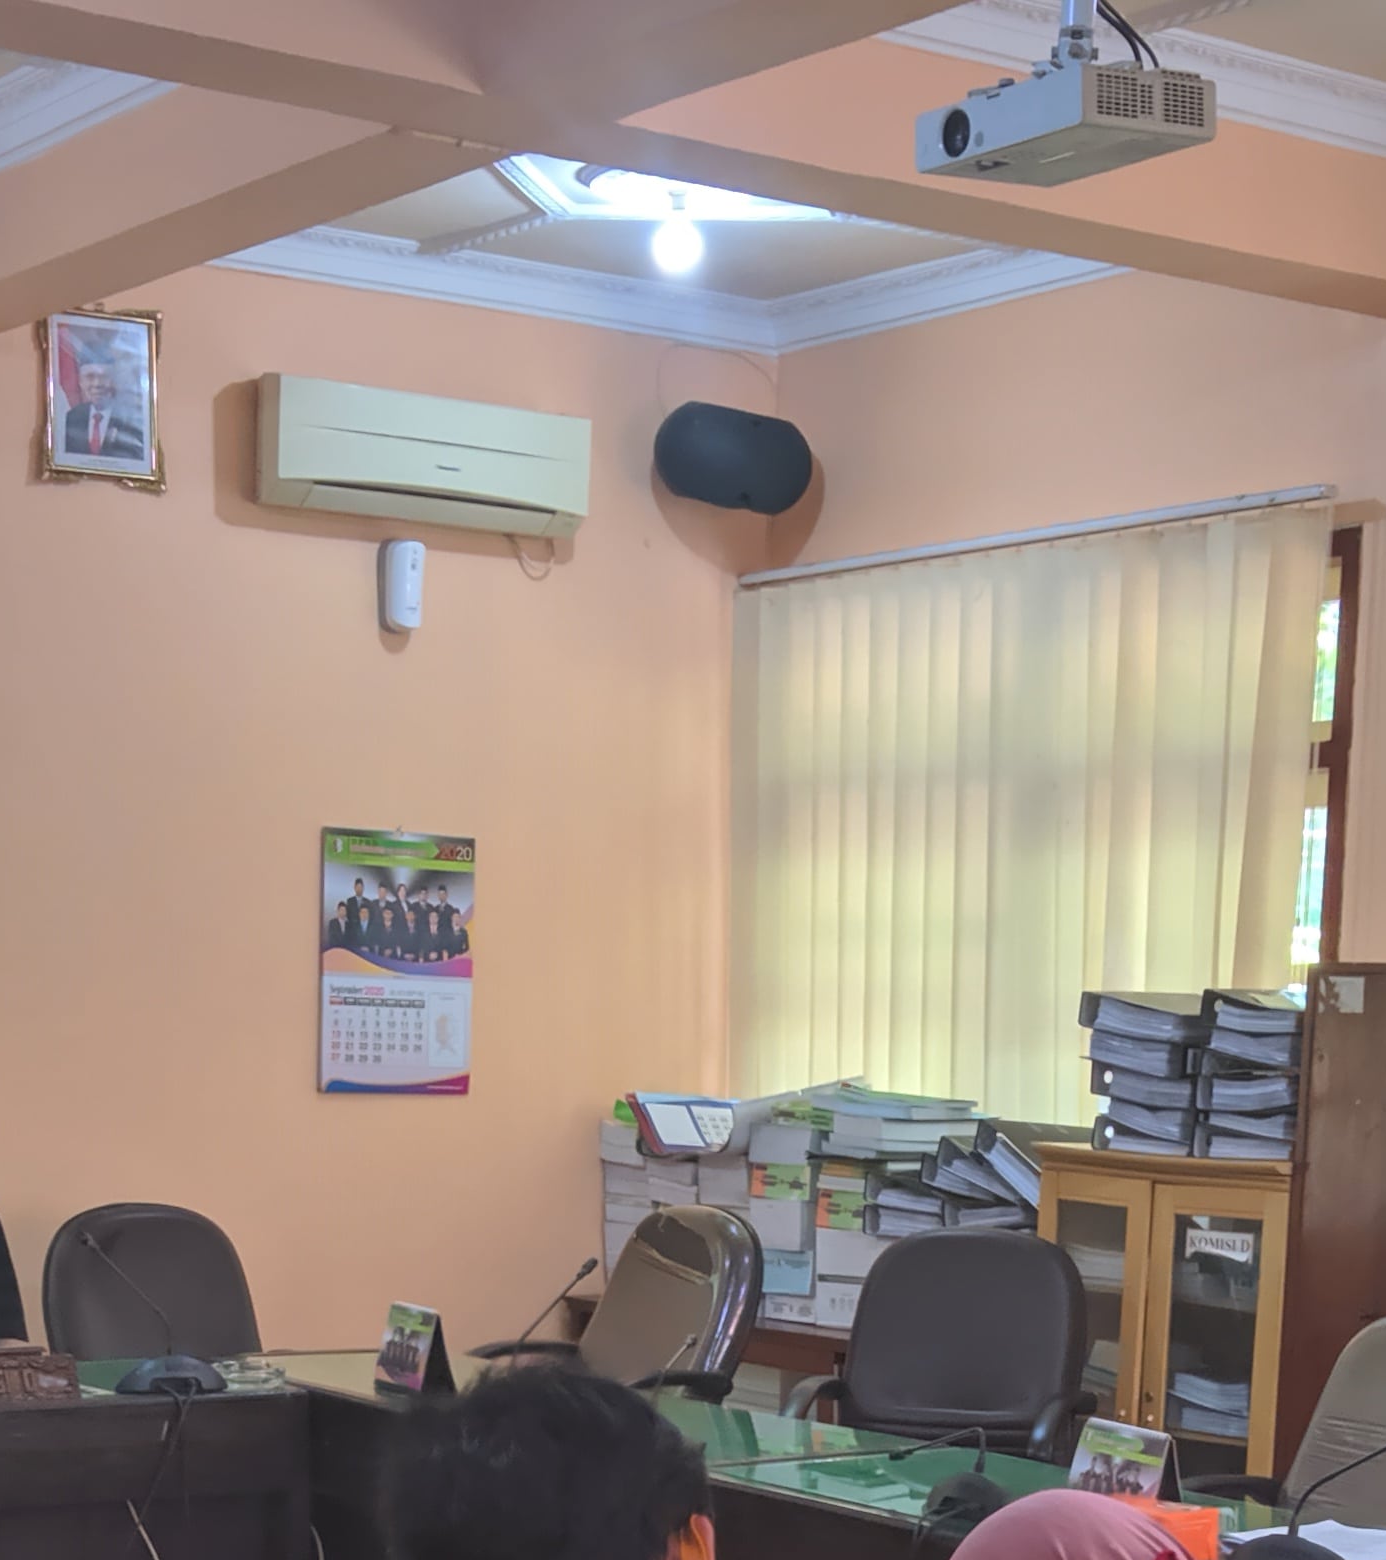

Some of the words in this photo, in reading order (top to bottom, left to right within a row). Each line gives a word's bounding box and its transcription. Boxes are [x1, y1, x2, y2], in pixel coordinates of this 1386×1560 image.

[440, 845, 472, 862] 2020
[1189, 1236, 1237, 1252] KOMISI
[1241, 1239, 1251, 1253] D
